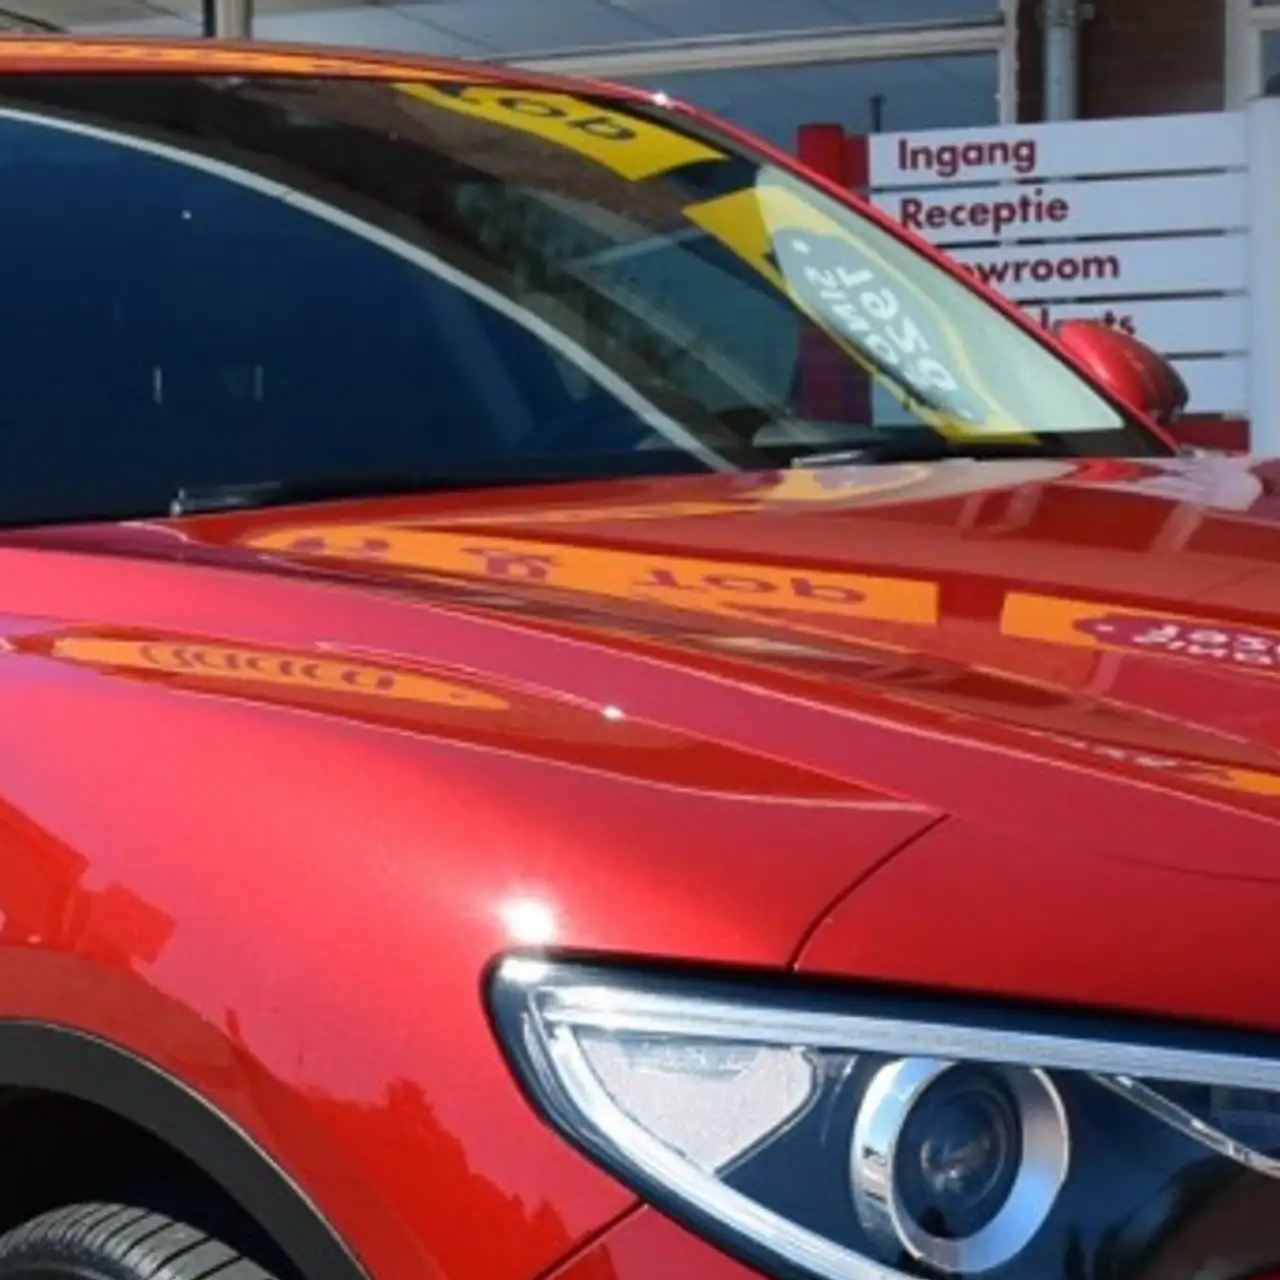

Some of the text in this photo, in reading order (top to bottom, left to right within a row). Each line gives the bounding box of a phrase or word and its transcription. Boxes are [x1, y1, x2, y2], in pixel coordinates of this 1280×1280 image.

[898, 139, 1037, 178] Ingang
[901, 188, 1070, 234] Receptie
[962, 254, 1121, 284] wroom
